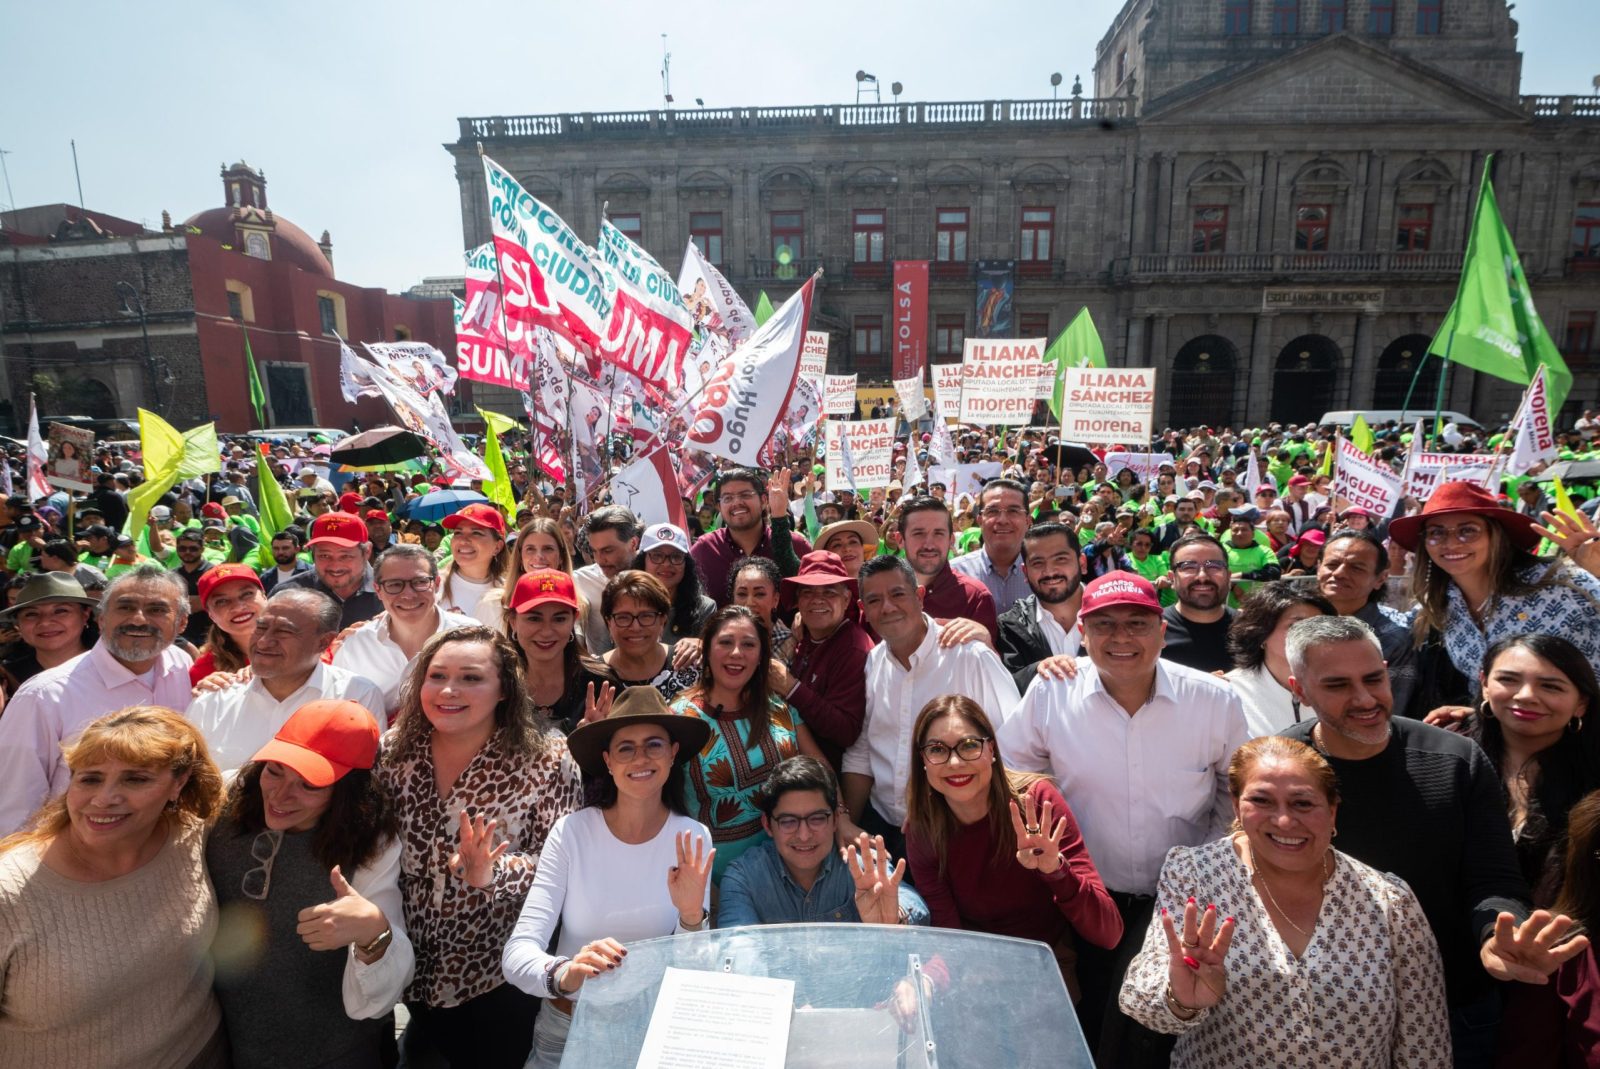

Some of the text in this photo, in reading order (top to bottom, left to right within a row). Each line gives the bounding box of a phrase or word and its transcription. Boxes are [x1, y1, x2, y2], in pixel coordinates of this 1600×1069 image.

[898, 281, 912, 352] TOLSÁ
[805, 335, 824, 345] ANA
[600, 308, 680, 393] UMA
[803, 345, 827, 355] CHEZ
[973, 345, 1040, 361] ILIANA
[457, 341, 530, 384] SUM
[799, 364, 823, 374] orena
[1080, 373, 1147, 388] ILIANA
[1070, 387, 1154, 403] SÁNCHEZ
[828, 400, 855, 408] moren
[968, 398, 1037, 412] morena
[1531, 377, 1552, 451] morena
[726, 391, 758, 455] Hugo
[836, 422, 889, 437] ILIANA
[1074, 418, 1143, 433] morena
[829, 436, 894, 451] SNCHEZ
[1337, 466, 1390, 503] MIGUEL
